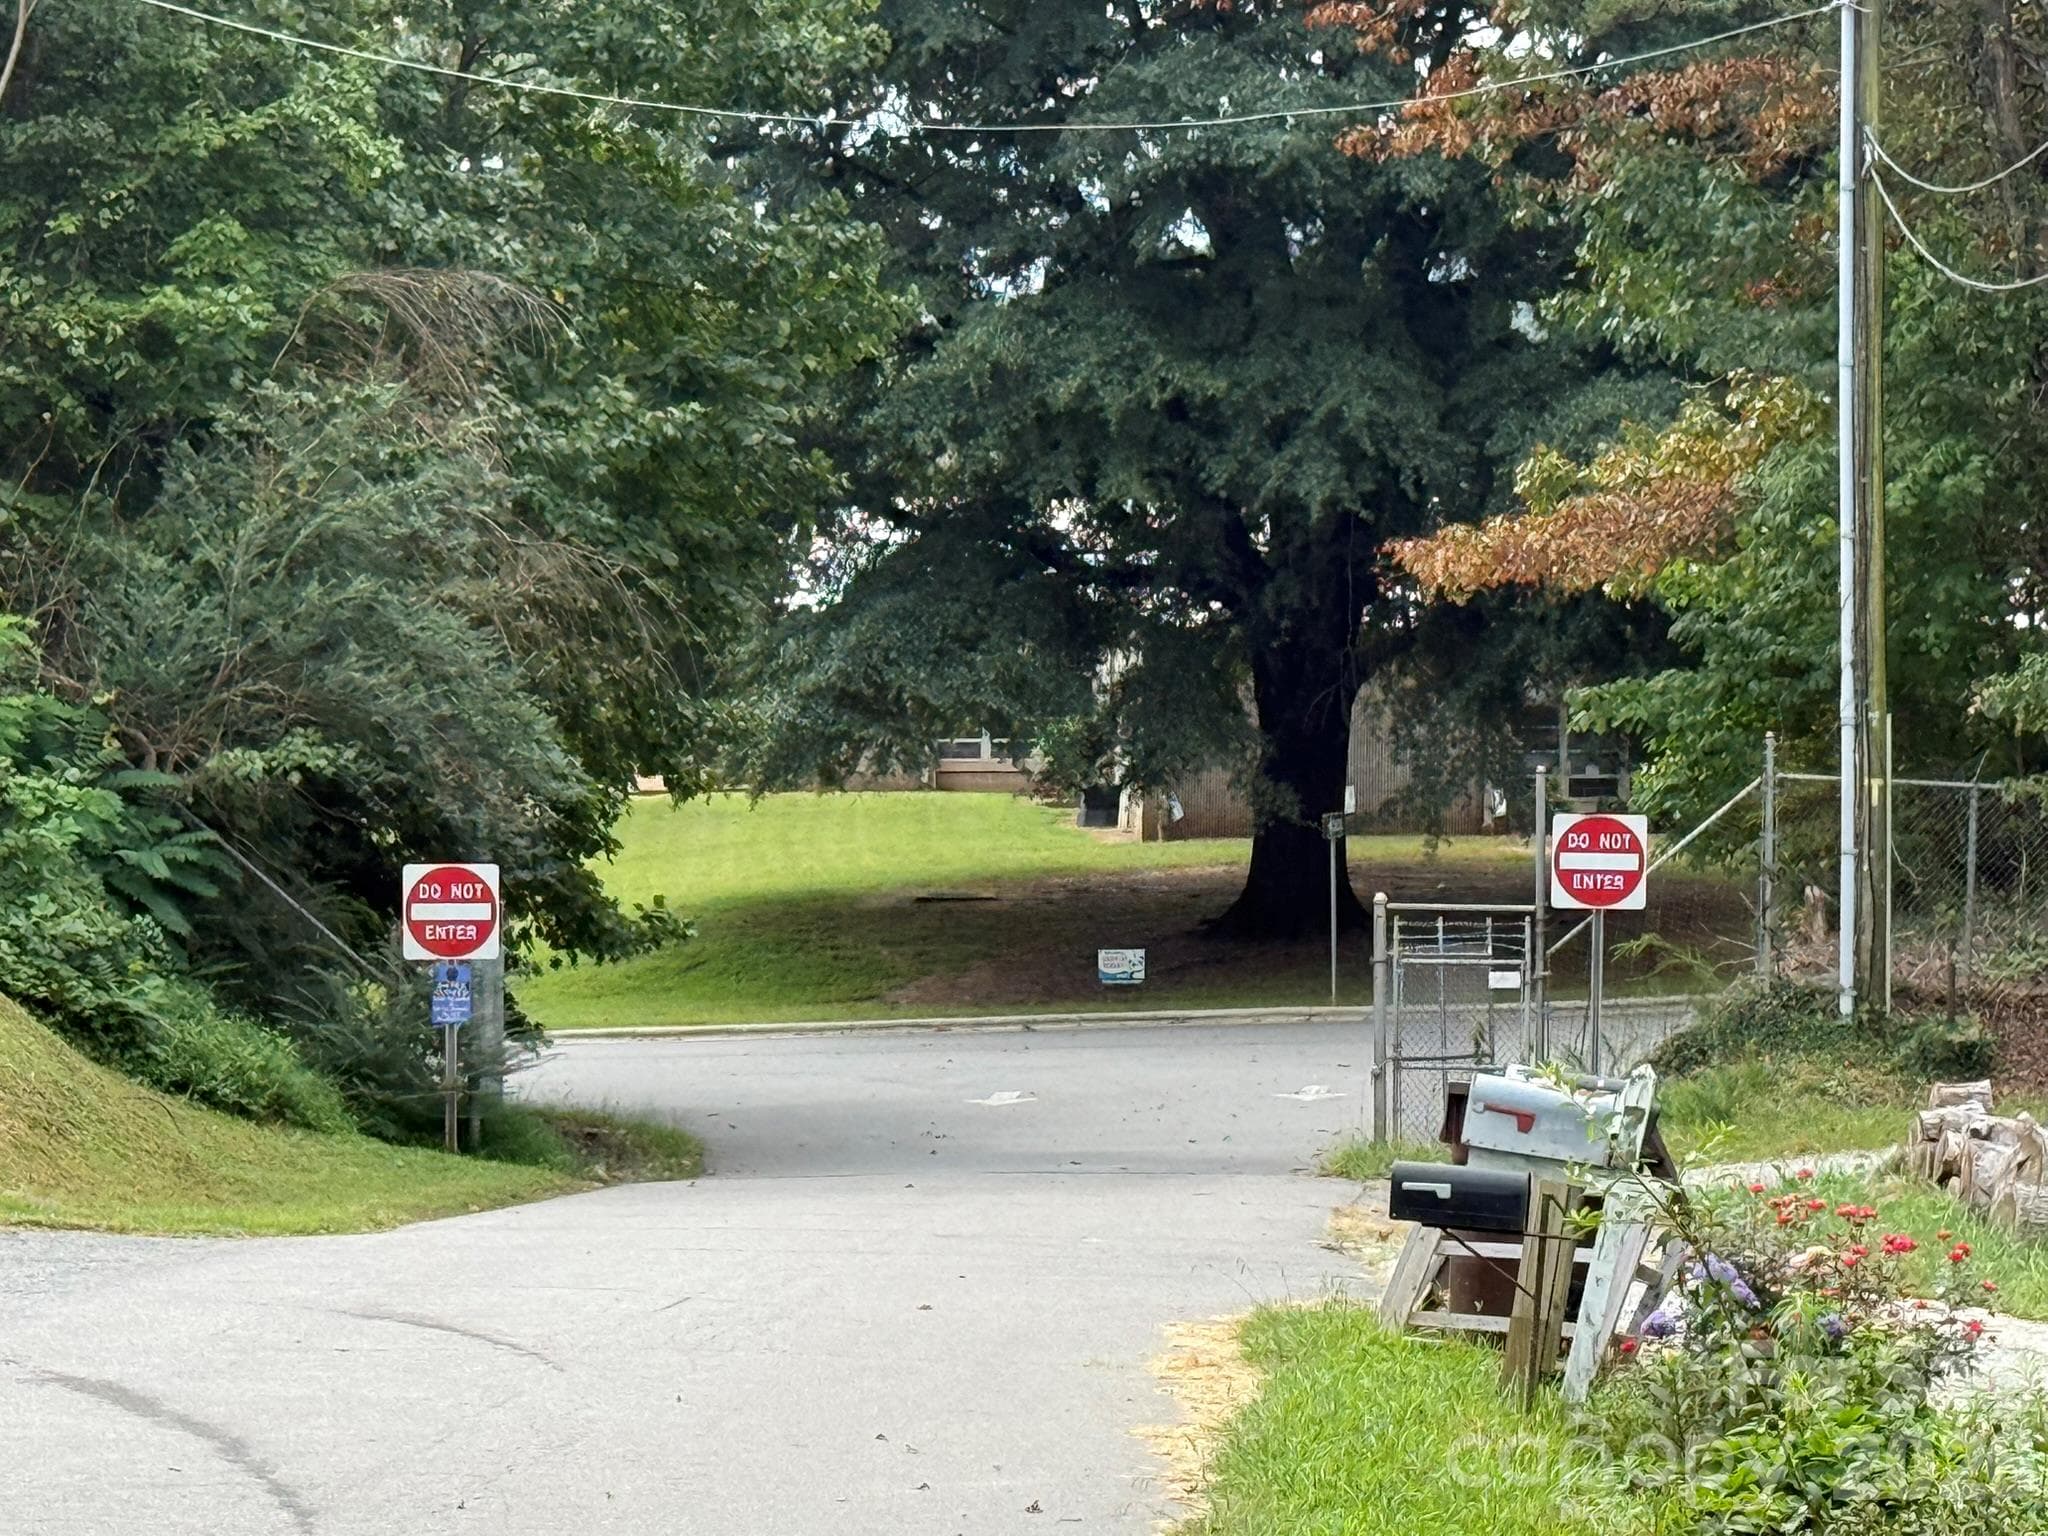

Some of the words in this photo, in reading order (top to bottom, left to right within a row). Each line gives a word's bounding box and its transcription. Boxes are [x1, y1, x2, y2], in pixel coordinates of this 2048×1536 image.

[1567, 832, 1590, 849] DO
[1599, 832, 1632, 850] NOT
[418, 882, 442, 900] DO
[450, 882, 484, 900] NOT
[425, 924, 478, 941] ENTER
